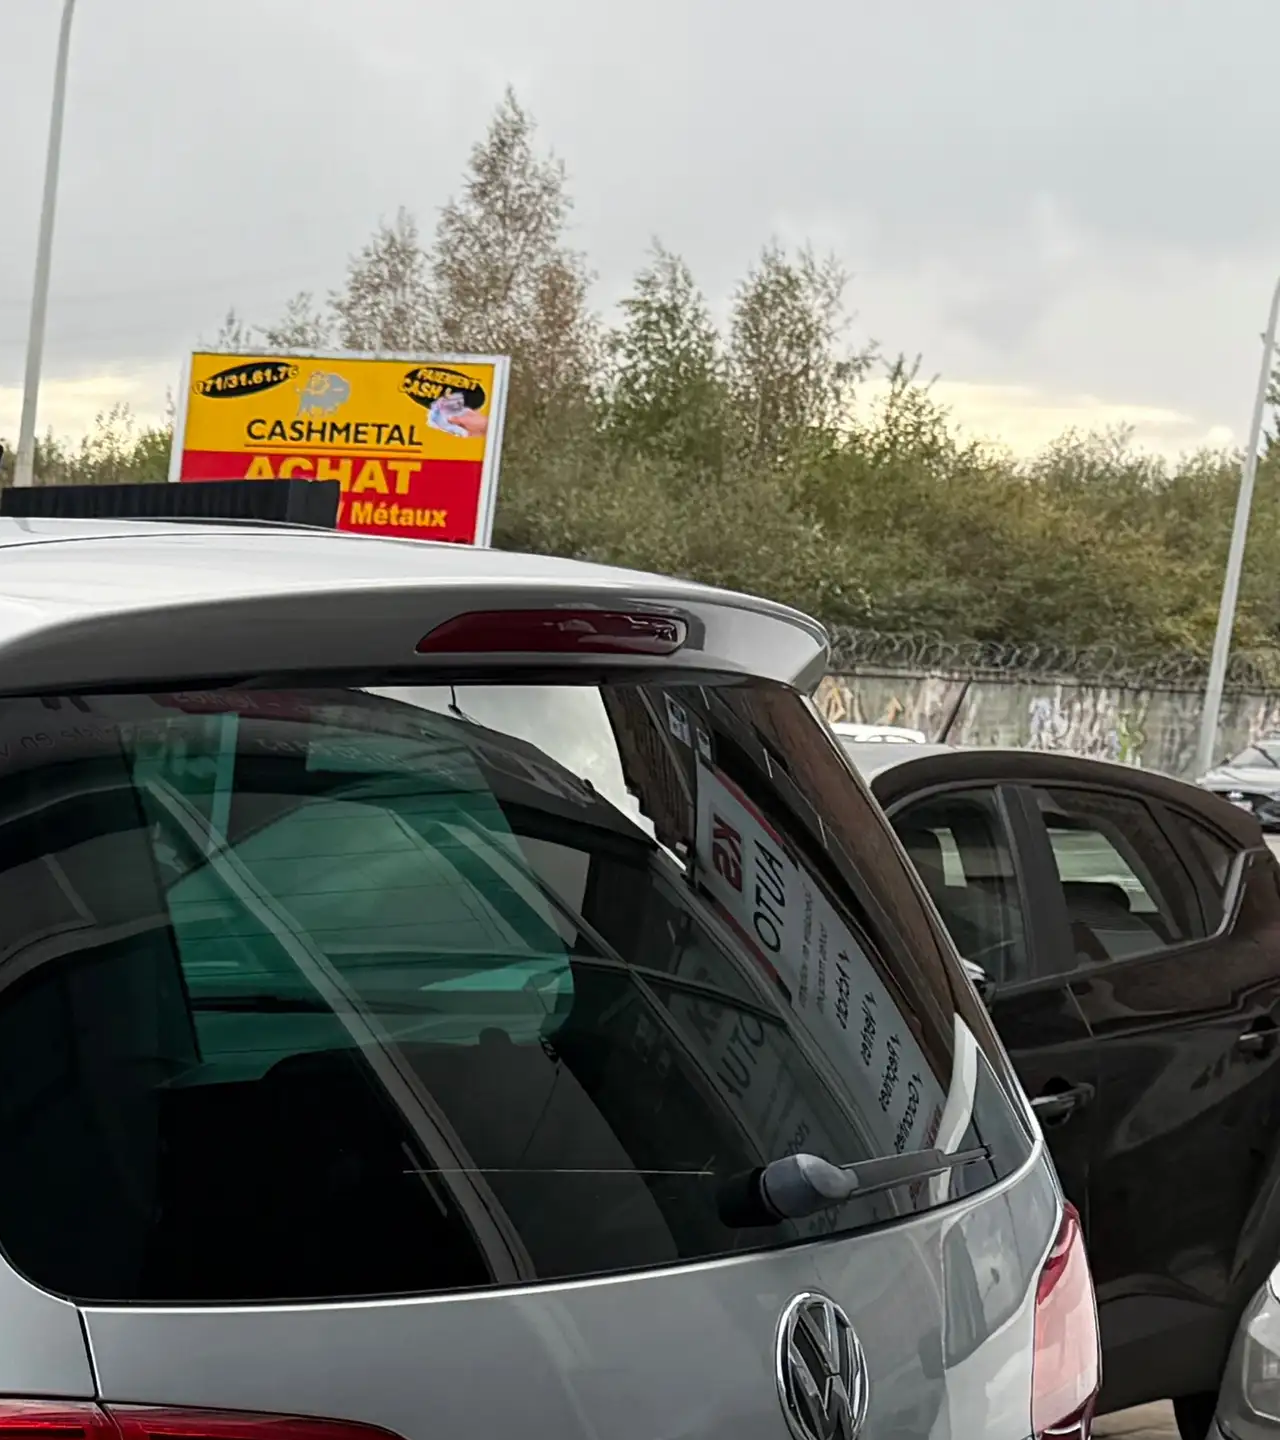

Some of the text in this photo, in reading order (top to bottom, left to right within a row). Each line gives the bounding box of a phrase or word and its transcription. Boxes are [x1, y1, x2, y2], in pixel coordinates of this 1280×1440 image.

[246, 418, 423, 446] CASHMETAL
[244, 455, 422, 495] ACHAT
[350, 500, 447, 528] Métaux
